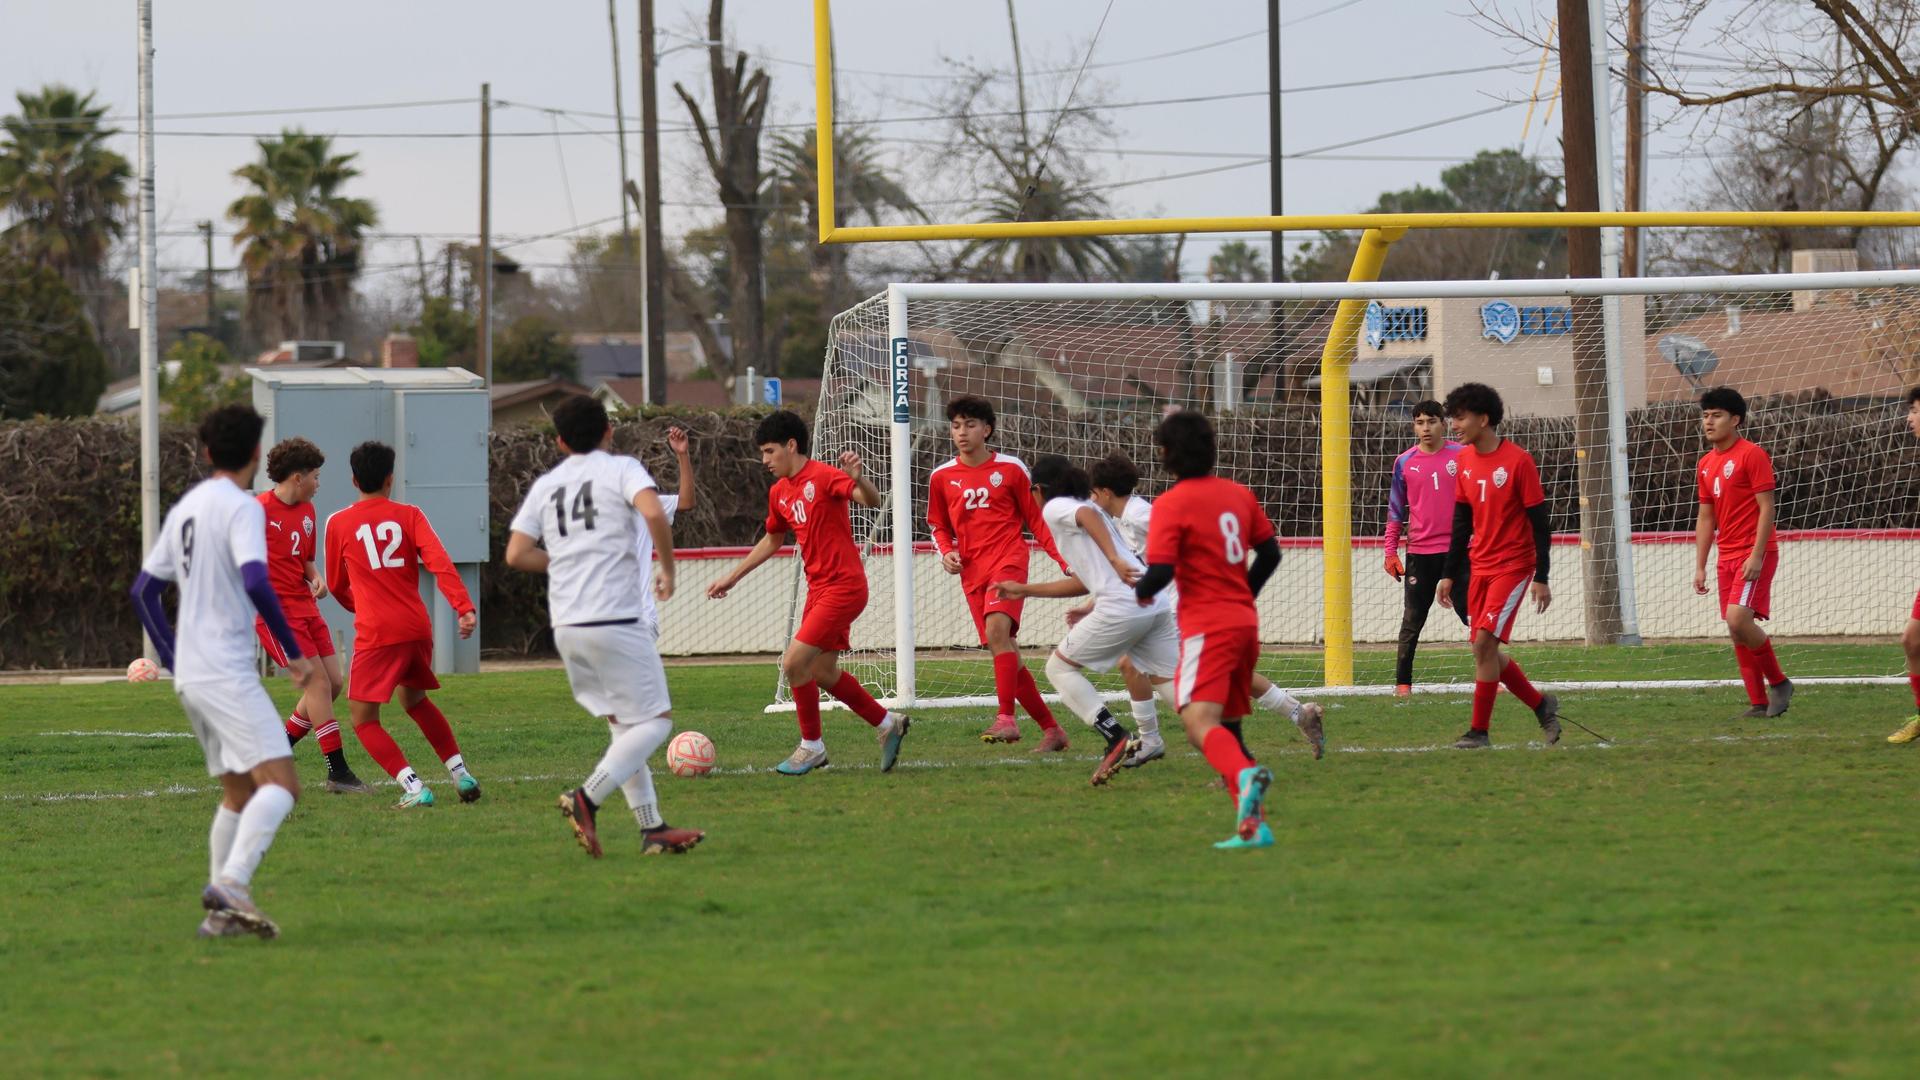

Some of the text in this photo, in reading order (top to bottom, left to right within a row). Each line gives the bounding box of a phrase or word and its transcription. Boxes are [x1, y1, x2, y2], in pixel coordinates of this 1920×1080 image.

[896, 342, 909, 407] FORZA
[1431, 471, 1439, 490] 1
[1477, 479, 1487, 502] 7
[1713, 476, 1721, 498] 4
[550, 480, 599, 538] 14
[963, 487, 990, 510] 22
[791, 499, 807, 525] 10
[181, 517, 195, 578] 9
[291, 530, 301, 556] 2
[355, 521, 404, 570] 12
[1219, 512, 1244, 564] 8
